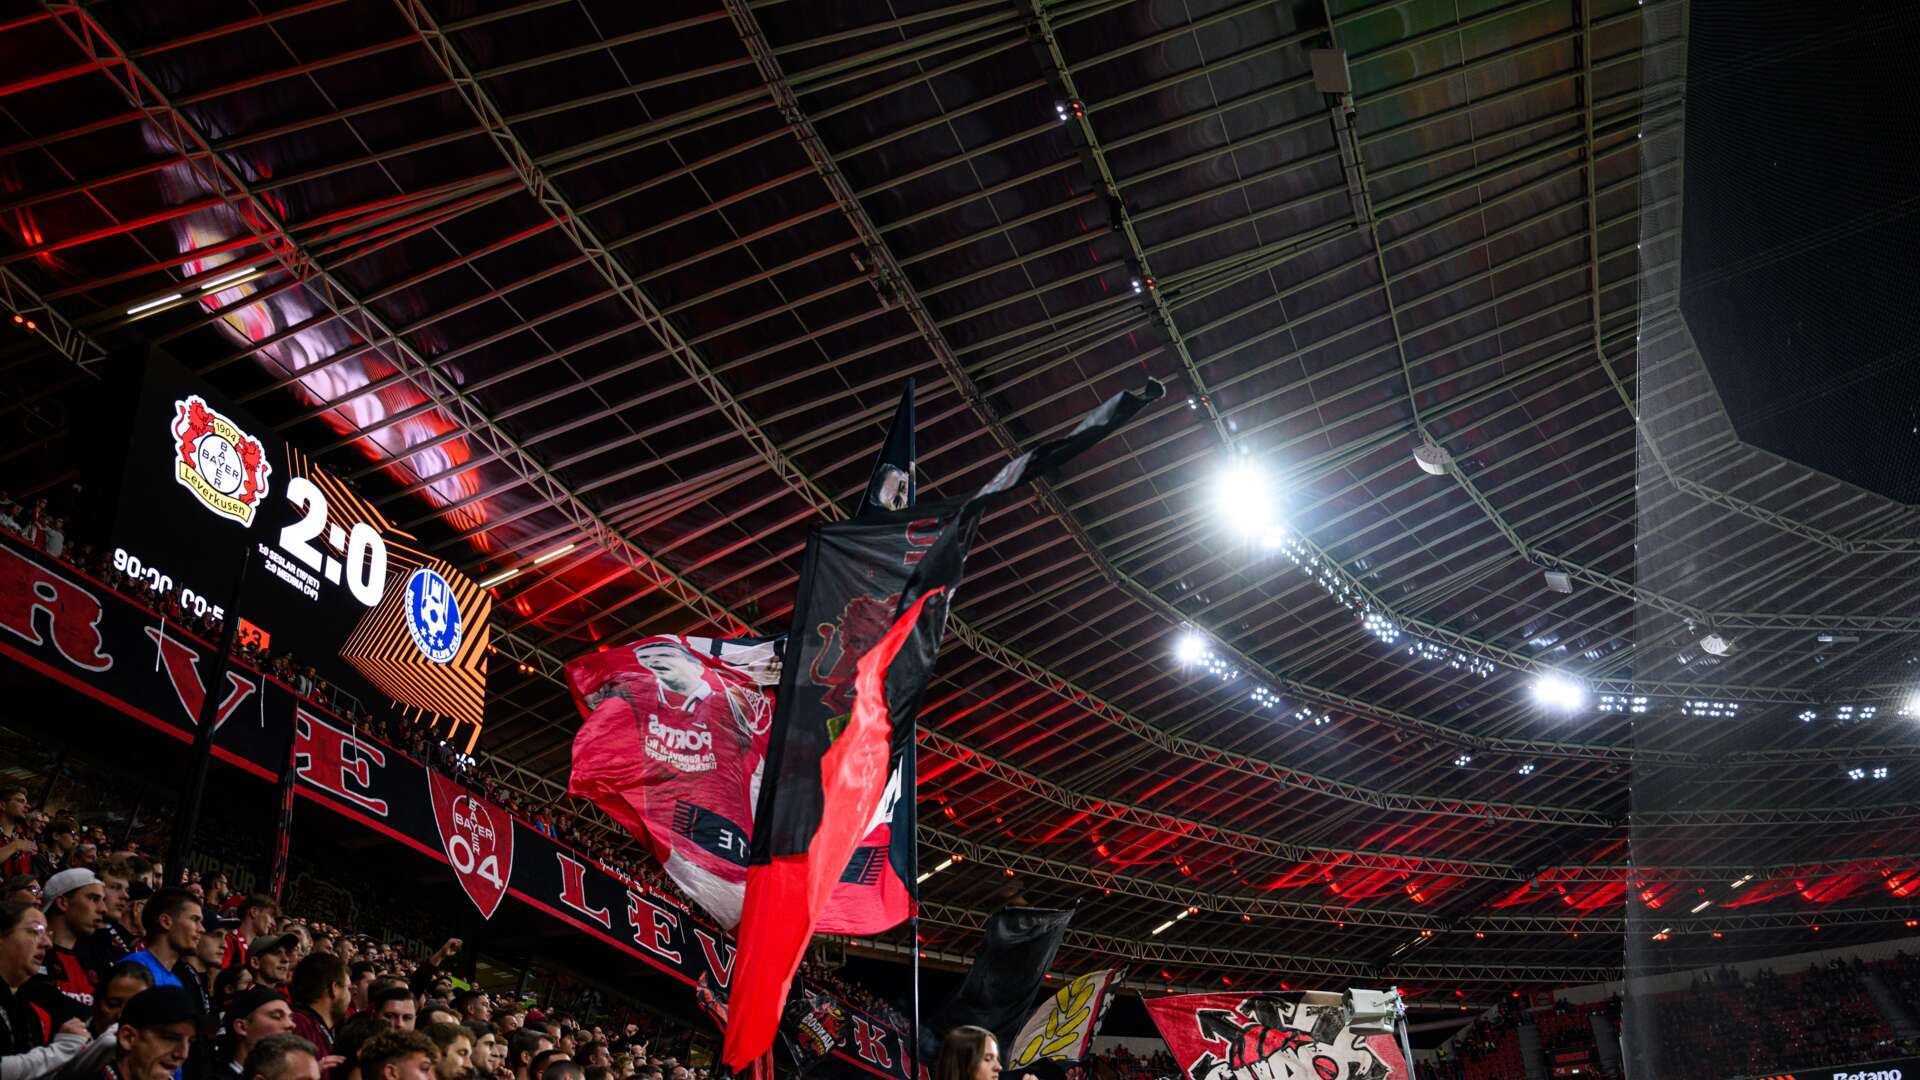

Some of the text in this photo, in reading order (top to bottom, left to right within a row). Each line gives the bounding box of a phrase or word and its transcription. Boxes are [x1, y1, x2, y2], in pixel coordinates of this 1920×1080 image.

[215, 422, 237, 442] 1904
[202, 449, 239, 480] BAYER
[213, 441, 228, 489] BAYER
[184, 467, 246, 516] Leverkusen
[279, 476, 388, 607] 2:0
[264, 559, 277, 574] 2:0
[268, 549, 296, 574] SESLAR
[455, 813, 493, 841] BAYER
[468, 798, 481, 856] BAYER
[449, 835, 503, 890] 04
